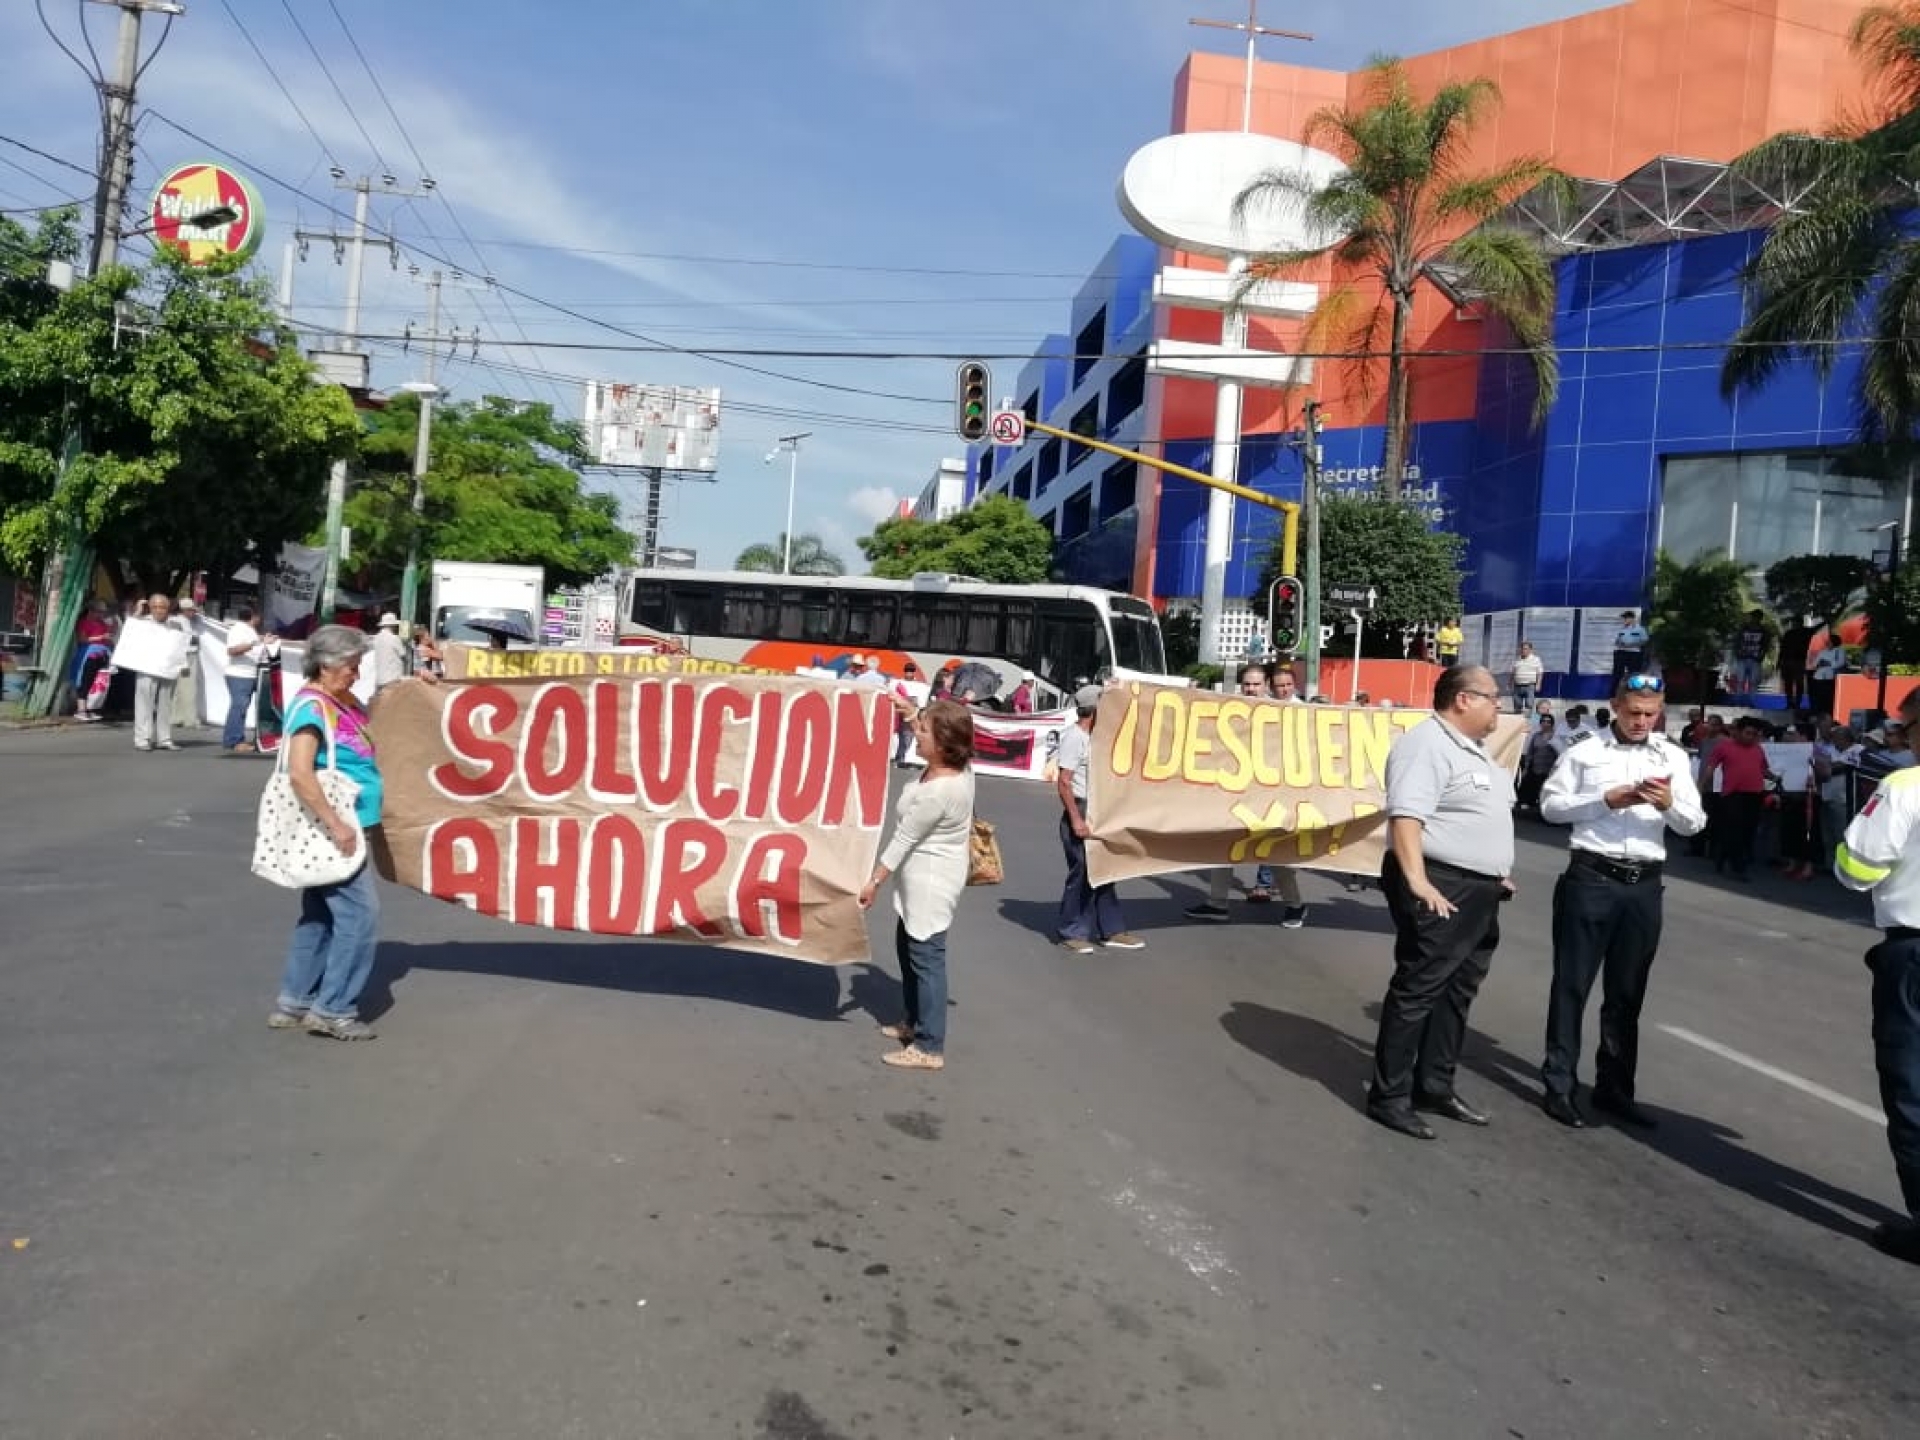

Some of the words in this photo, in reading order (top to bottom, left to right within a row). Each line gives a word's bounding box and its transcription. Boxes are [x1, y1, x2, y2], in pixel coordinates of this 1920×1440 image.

[161, 193, 243, 224] Wald's
[1316, 459, 1421, 482] ecretía
[467, 648, 585, 677] RESPETO
[429, 678, 895, 829] SOLUCION
[422, 812, 808, 945] AHORA
